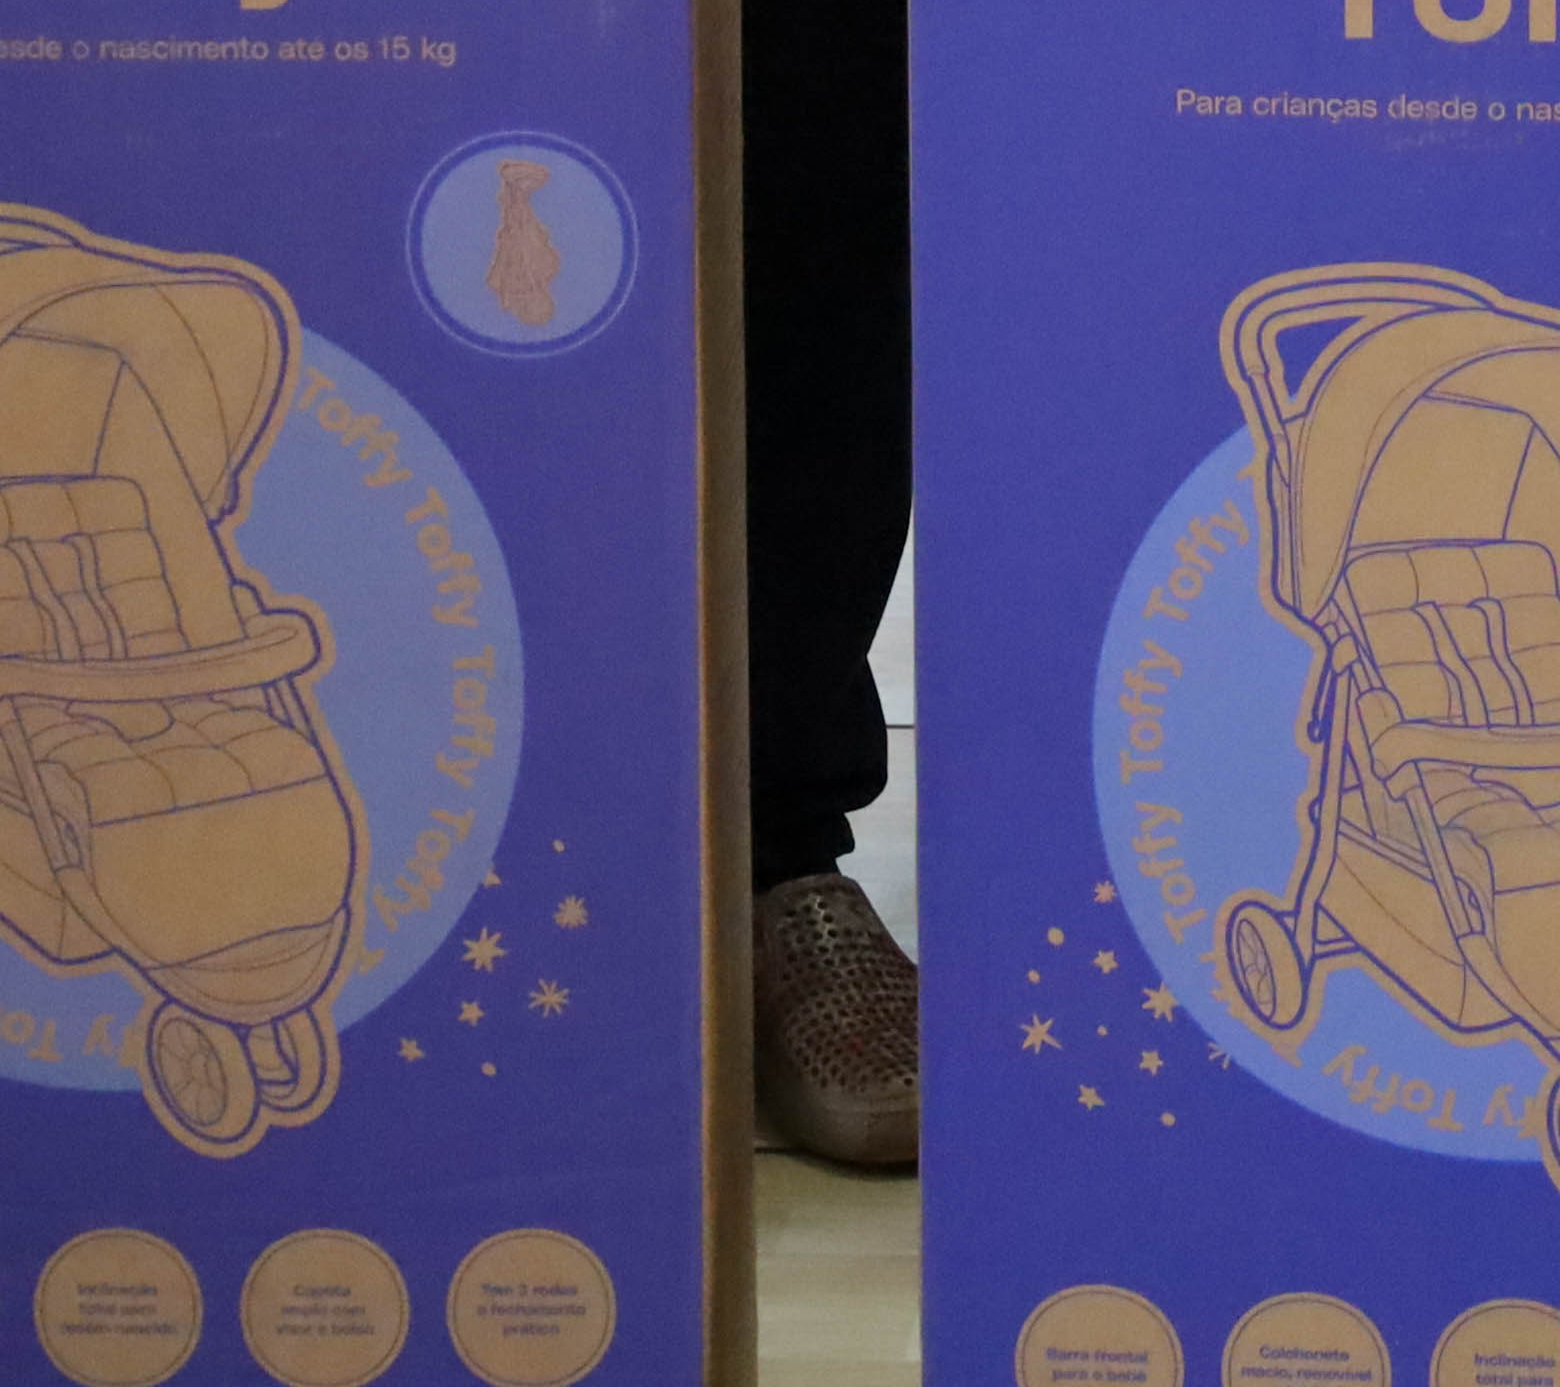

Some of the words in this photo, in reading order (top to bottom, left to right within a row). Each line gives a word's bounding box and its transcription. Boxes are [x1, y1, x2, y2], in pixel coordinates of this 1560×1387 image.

[71, 40, 90, 61] o
[97, 34, 269, 61] nascimento
[278, 33, 324, 62] até
[334, 40, 370, 62] os
[379, 36, 412, 62] 15
[420, 36, 458, 68] kg
[1175, 89, 1244, 118] Para
[1252, 90, 1378, 127] crianças
[1387, 91, 1479, 122] desde
[1487, 101, 1508, 123] o
[1144, 504, 1251, 626] Toffy
[1122, 639, 1183, 785] Toffy
[1129, 800, 1206, 943] Toffy
[1321, 1044, 1464, 1133] Toffy
